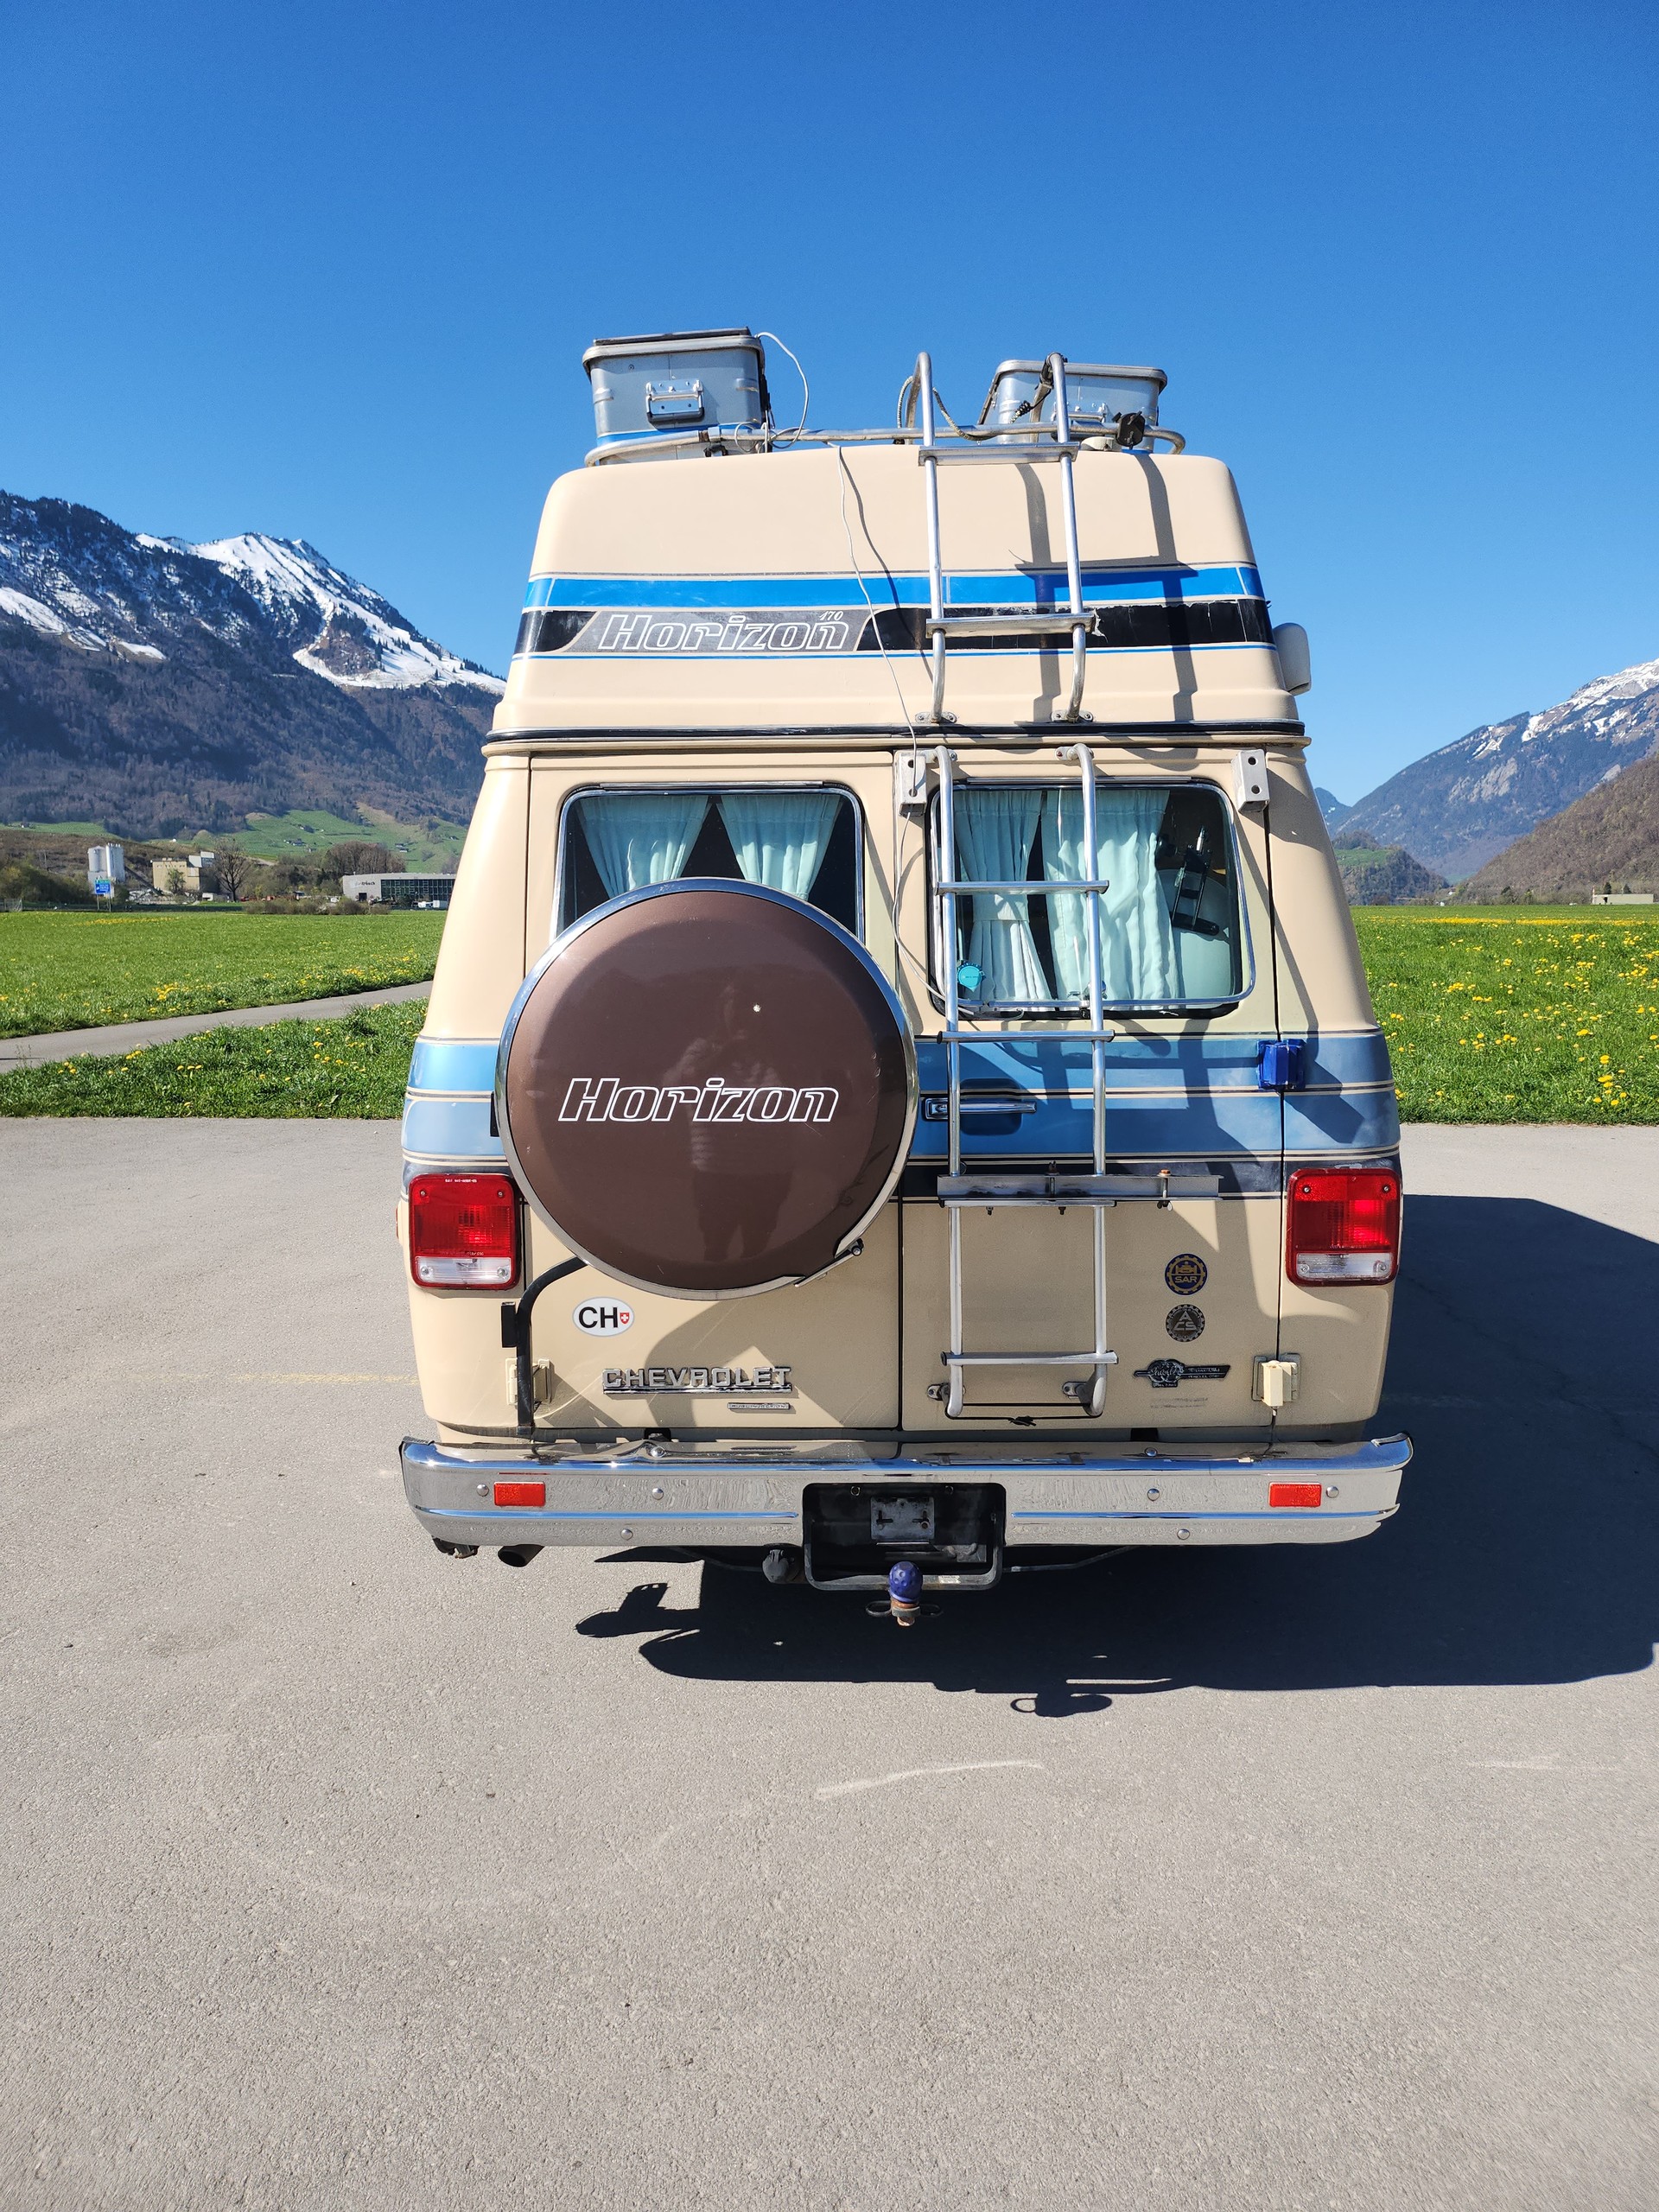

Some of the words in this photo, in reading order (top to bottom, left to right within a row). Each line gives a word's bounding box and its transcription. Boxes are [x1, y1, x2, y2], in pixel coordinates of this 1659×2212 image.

[598, 614, 849, 650] Horizon
[818, 610, 844, 621] 170
[558, 1077, 839, 1122] Horizon
[578, 1306, 619, 1329] CH
[602, 1367, 791, 1388] CHEVROLET
